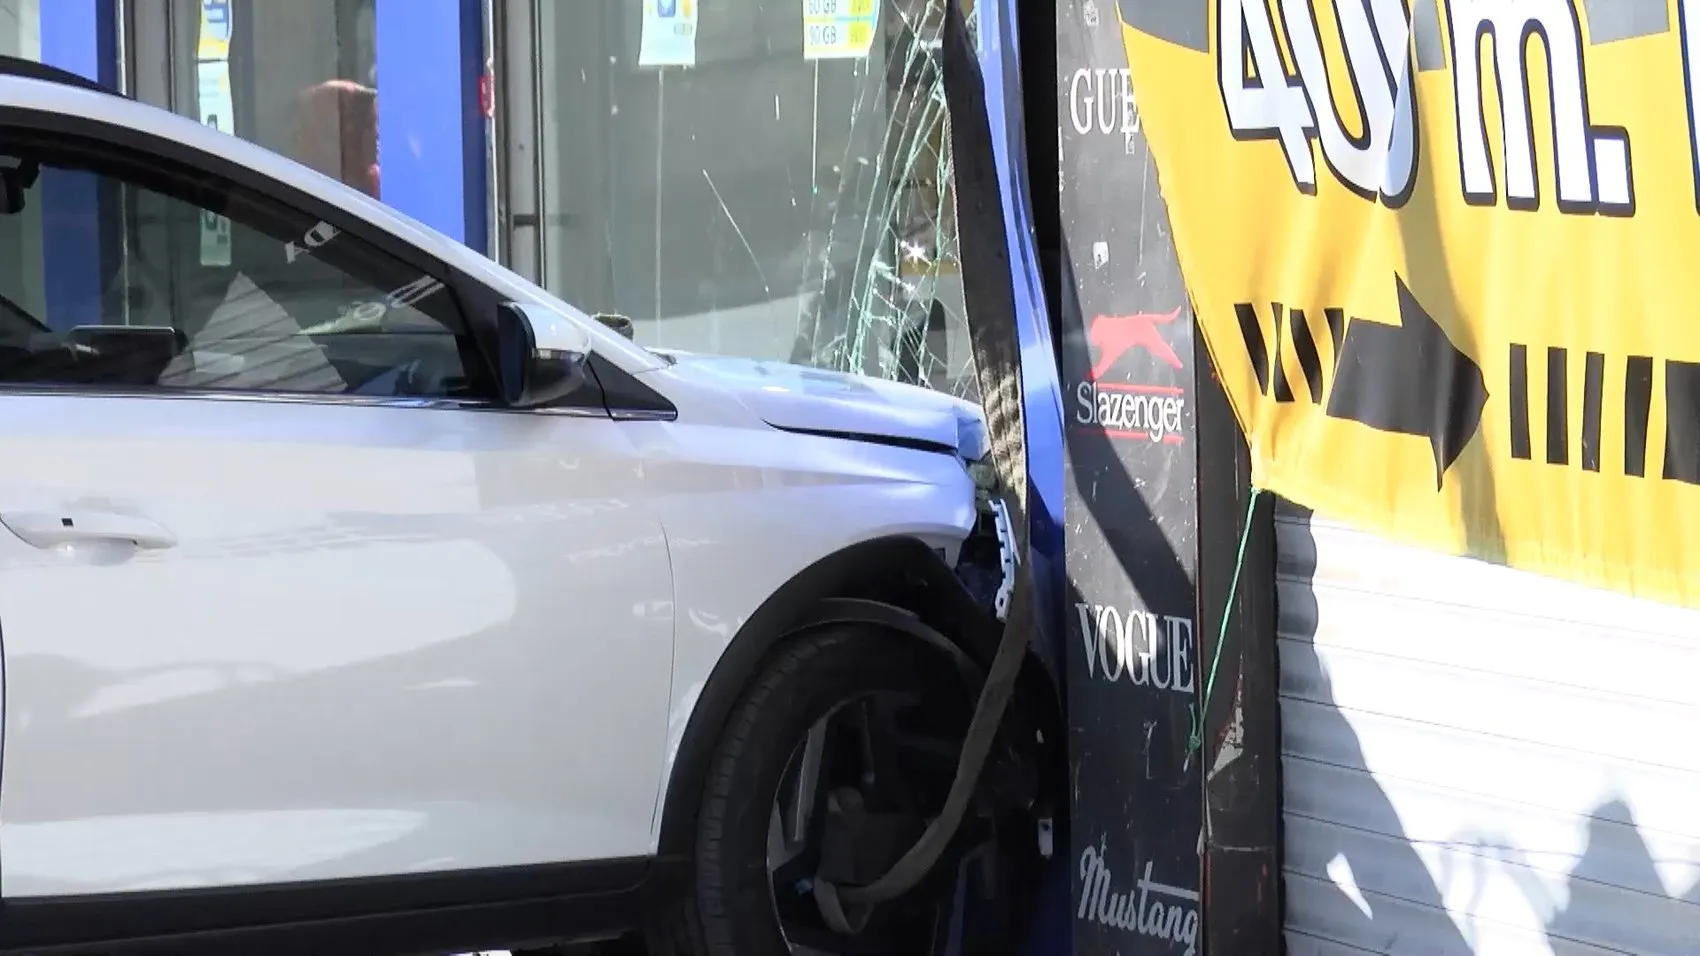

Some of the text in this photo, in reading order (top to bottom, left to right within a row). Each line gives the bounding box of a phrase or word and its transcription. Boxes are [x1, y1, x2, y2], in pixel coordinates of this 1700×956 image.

[822, 0, 837, 14] GB
[822, 25, 837, 45] GB
[1217, 0, 1420, 209] 40
[1076, 381, 1185, 443] Slazenger
[1074, 602, 1194, 694] VOGUE
[1077, 845, 1200, 956] Mustang
